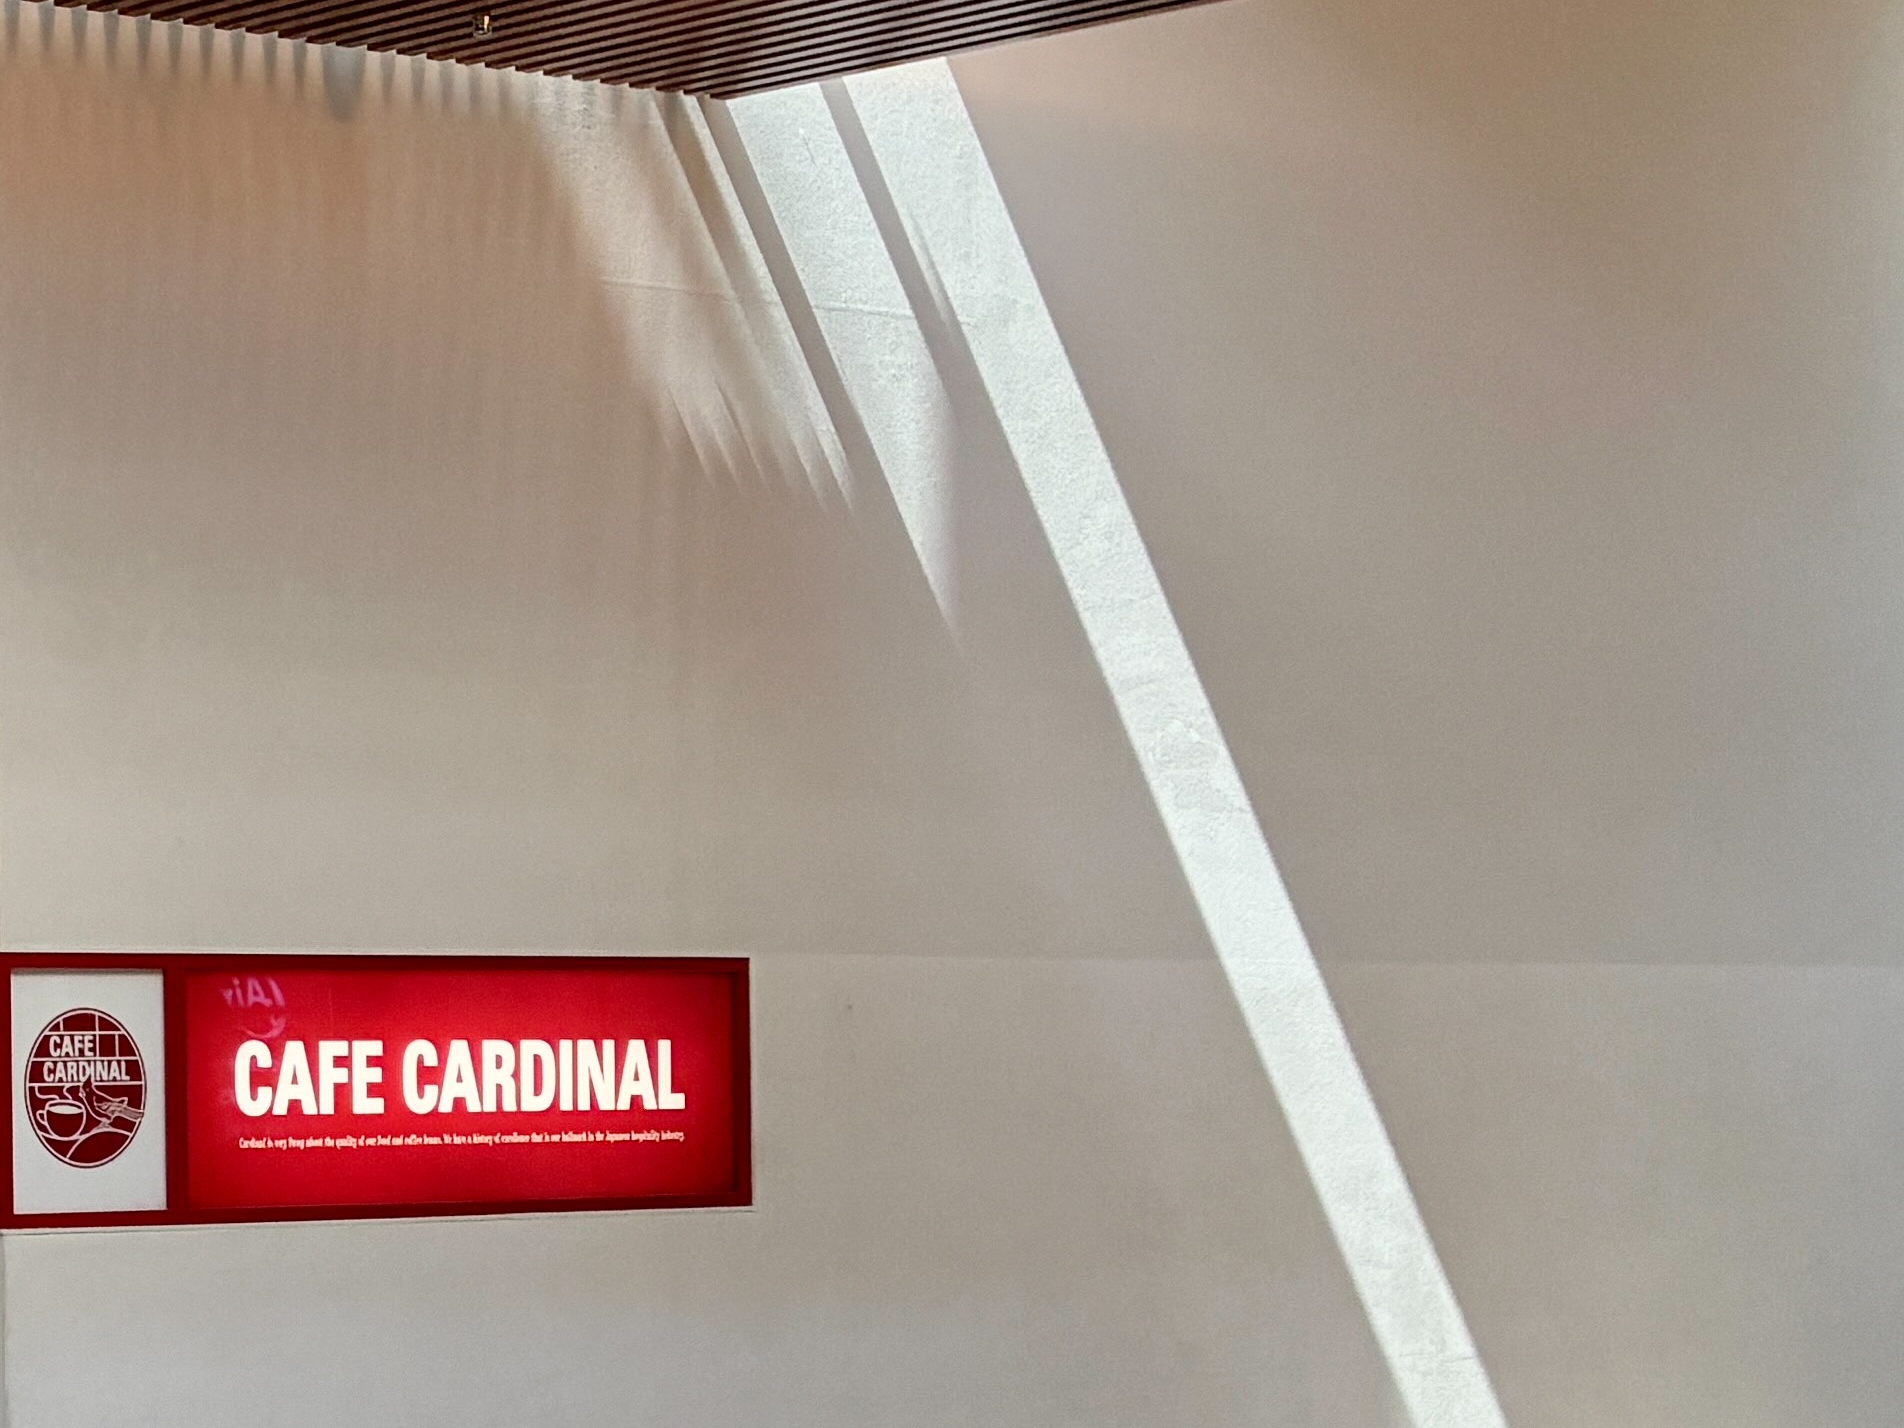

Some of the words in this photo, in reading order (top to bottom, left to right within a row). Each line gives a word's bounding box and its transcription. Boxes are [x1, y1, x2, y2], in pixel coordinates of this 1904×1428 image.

[49, 1035, 94, 1058] CAFE
[43, 1061, 130, 1083] CARDINAL
[234, 1039, 385, 1118] CAFE
[403, 1038, 686, 1114] CARDINAL
[336, 1135, 357, 1150] quality
